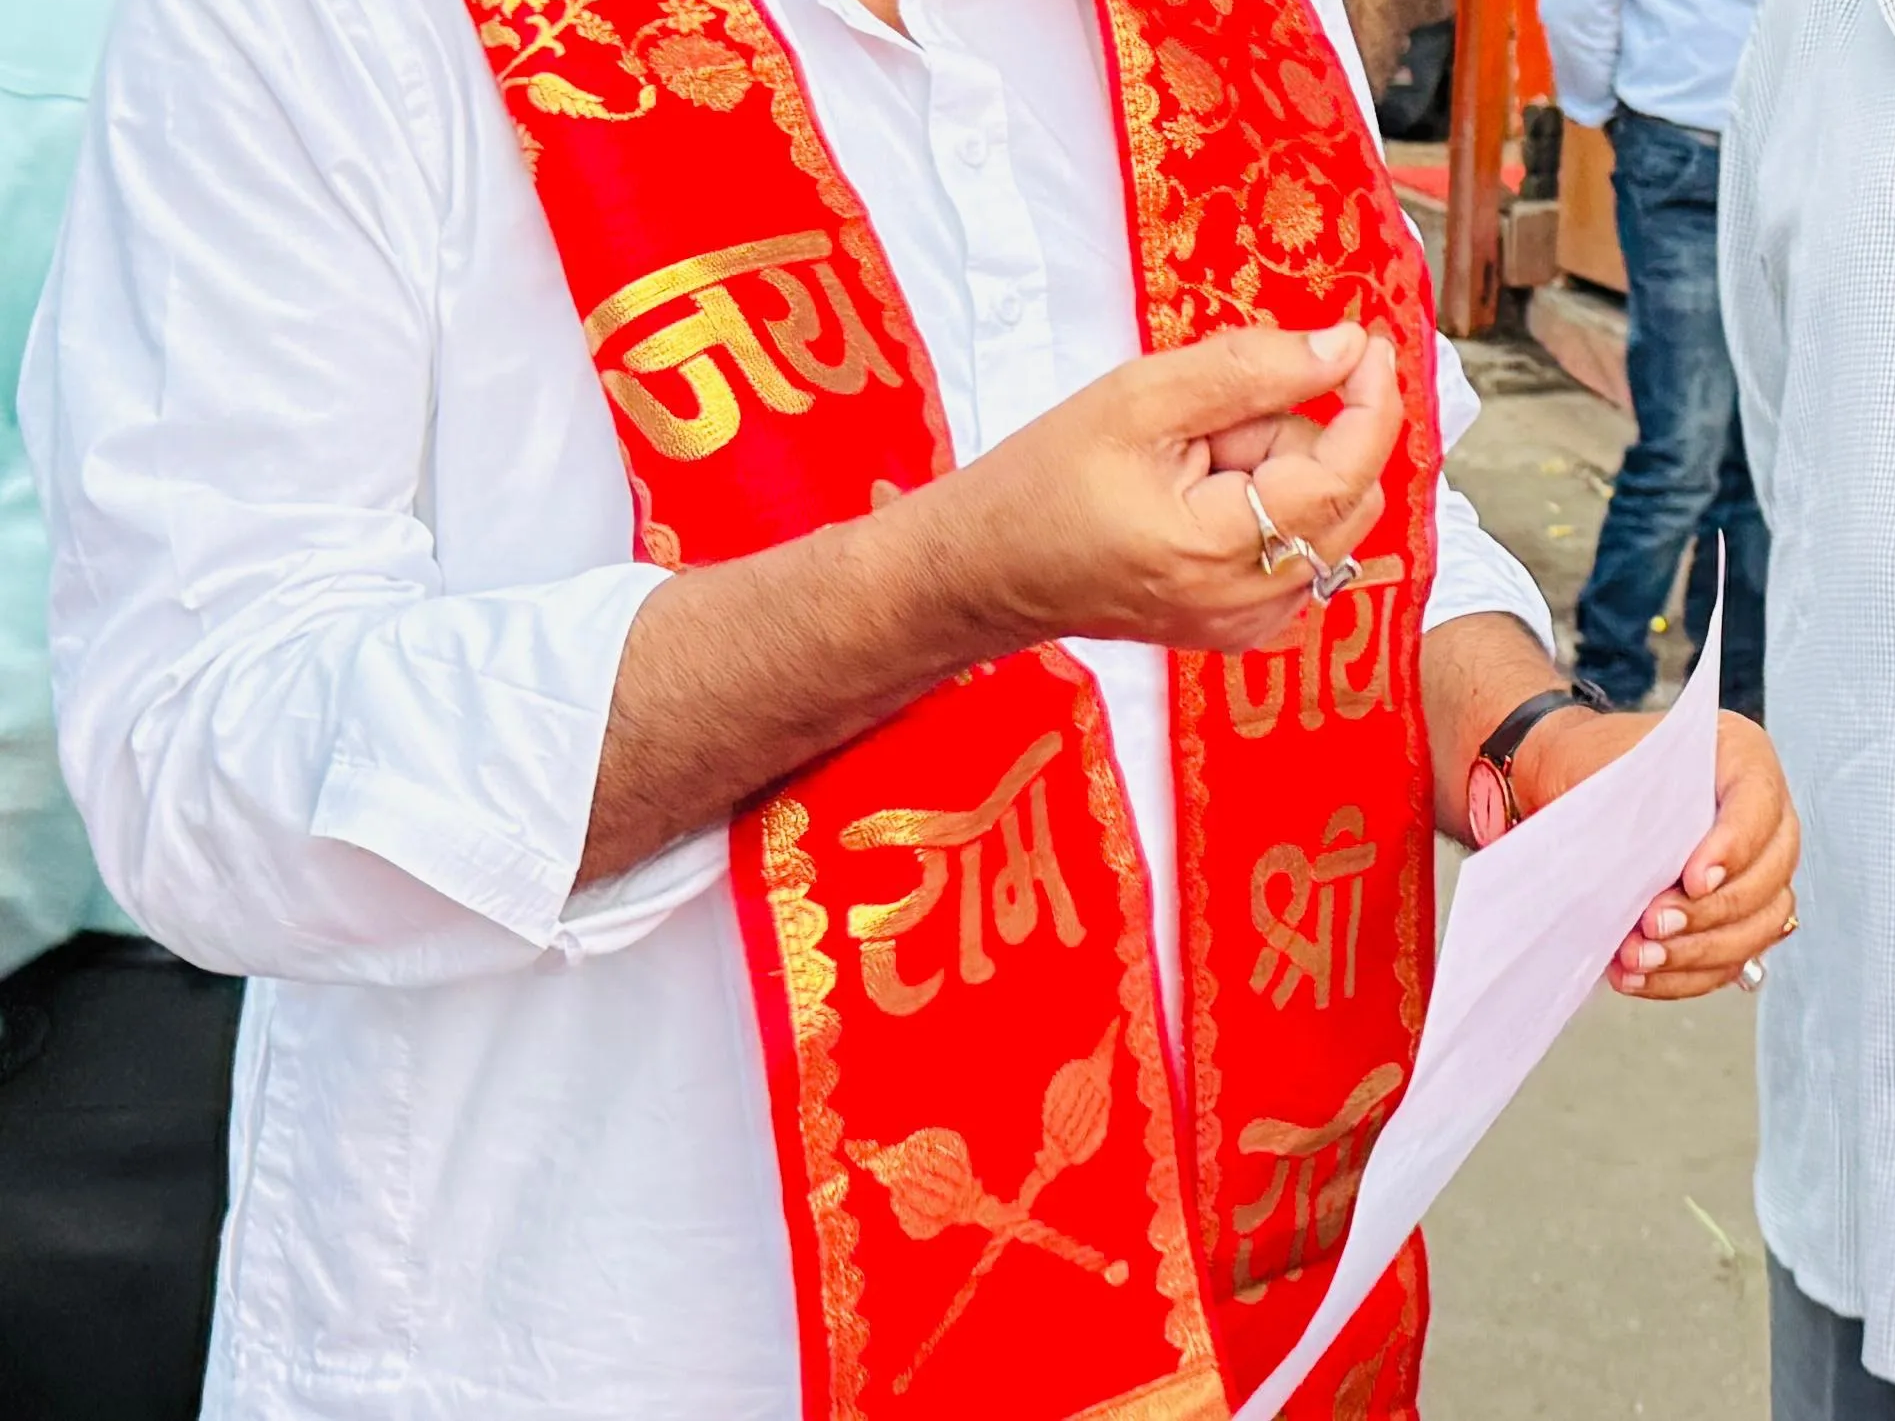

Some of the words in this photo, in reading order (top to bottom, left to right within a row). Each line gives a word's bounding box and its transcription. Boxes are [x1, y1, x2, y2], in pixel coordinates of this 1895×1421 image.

[584, 229, 903, 461] जय
[838, 731, 1087, 1017] राम
[1249, 804, 1379, 1011] श्री
